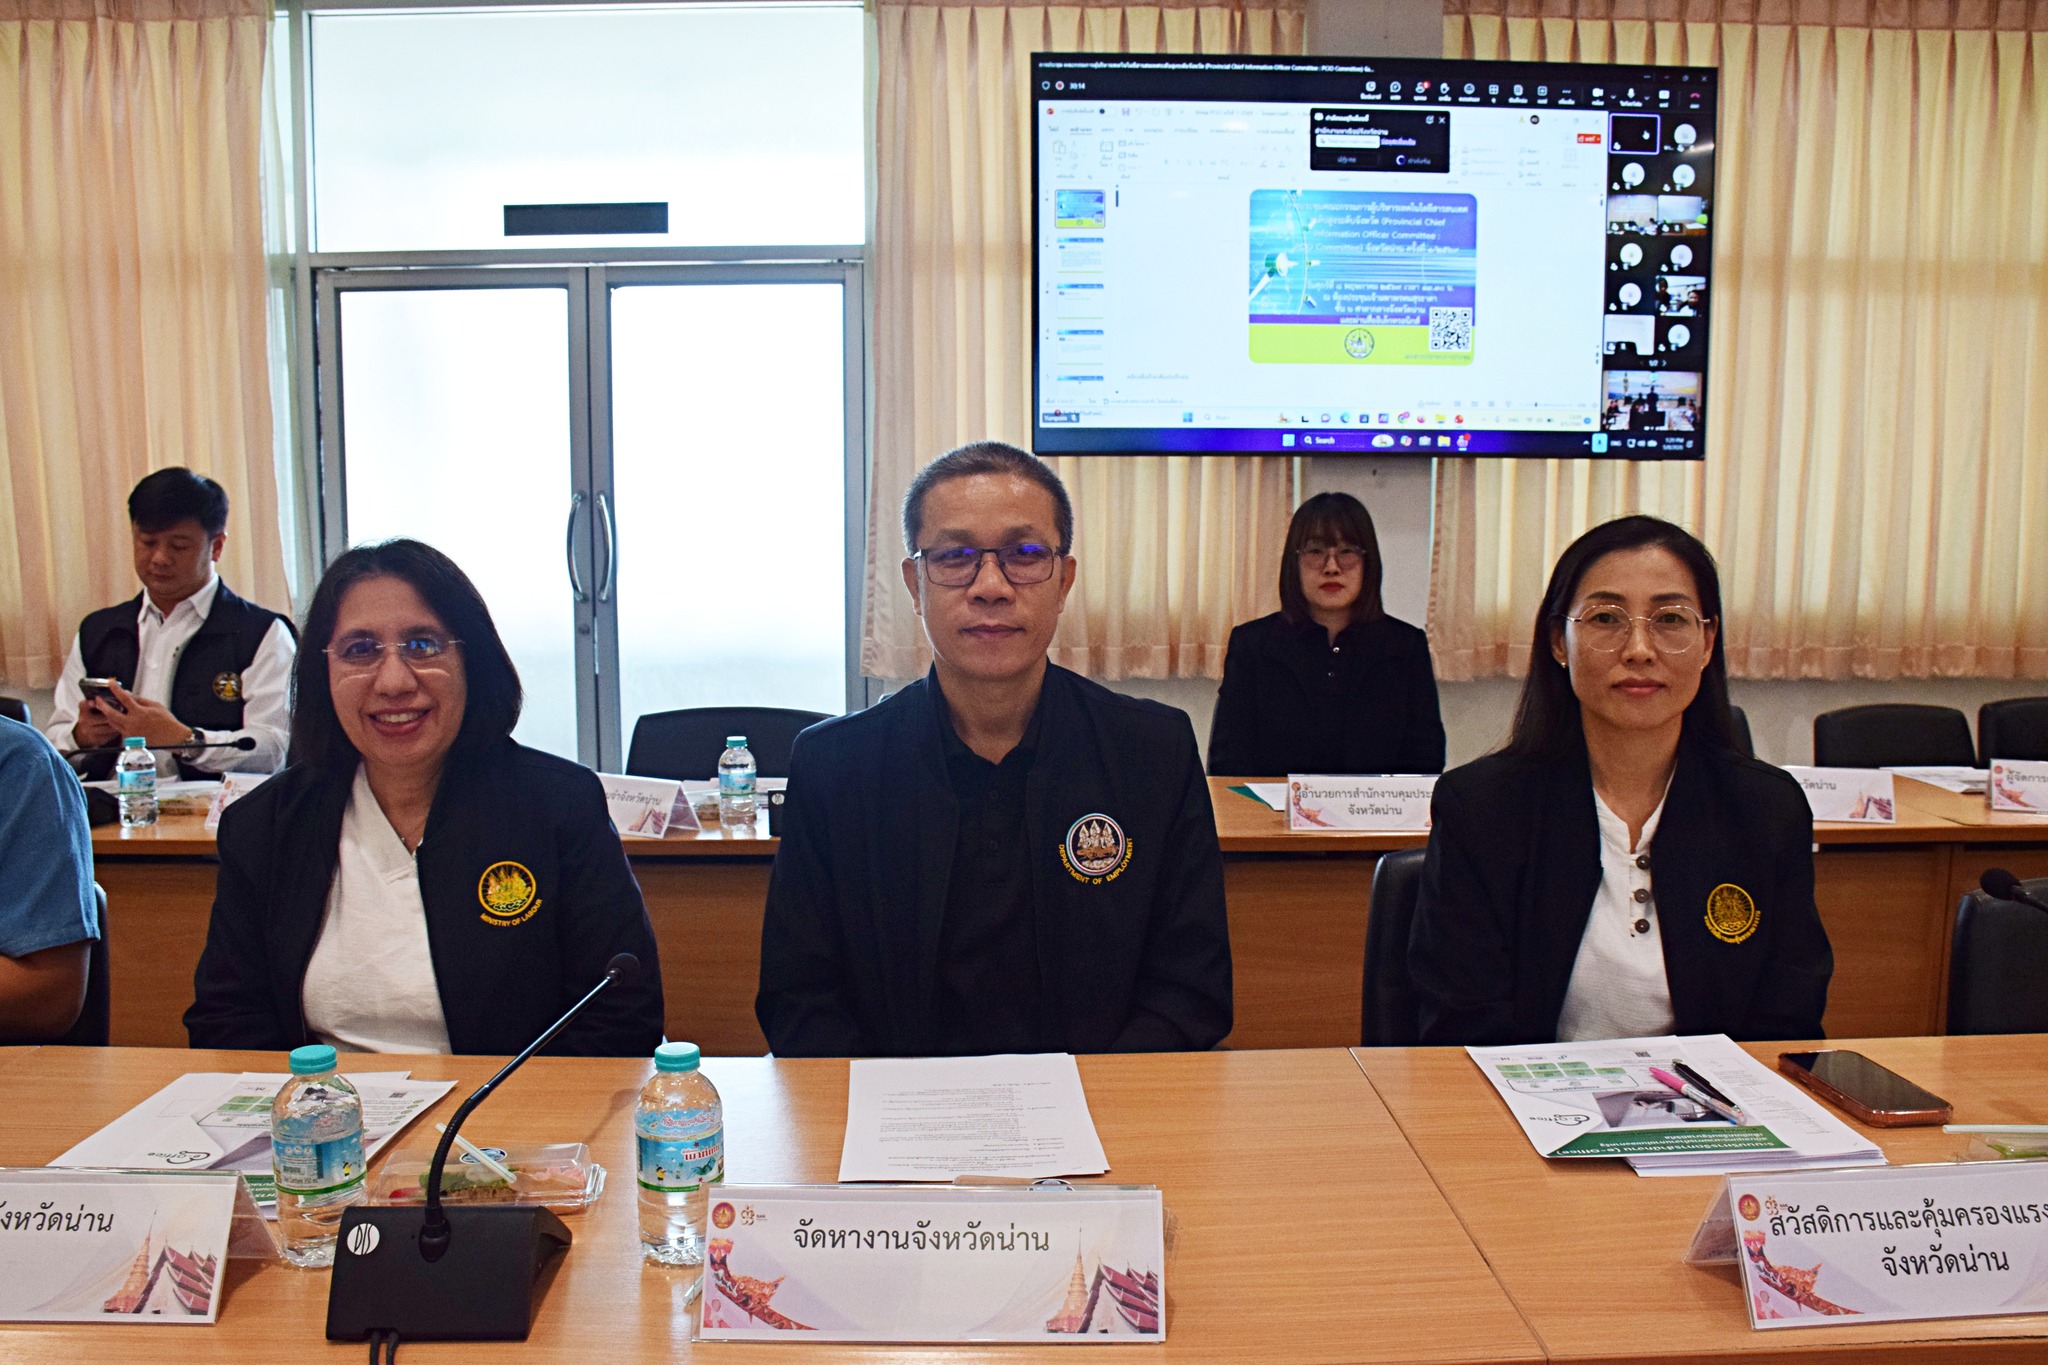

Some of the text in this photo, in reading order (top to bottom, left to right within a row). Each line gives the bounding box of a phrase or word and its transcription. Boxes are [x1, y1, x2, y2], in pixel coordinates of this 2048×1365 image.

[1424, 218, 1446, 226] Chief
[1362, 230, 1389, 238] Officer
[1391, 230, 1436, 239] Committee
[1800, 778, 1836, 791] วัดน่าน
[2006, 768, 2048, 785] ผู้จัดการ
[1299, 787, 1432, 802] อำนวยการสำนักงานคุมประ
[1348, 803, 1402, 816] จังหวัดน่าน
[1058, 837, 1133, 885] DEPARTMENT OF EMPLOYMENT
[480, 898, 543, 927] MINISTRY OF LABOUR
[793, 1218, 1050, 1252] จัดหางานจังหวัดน่าน
[1881, 1243, 2010, 1278] จังหวัดน่าน
